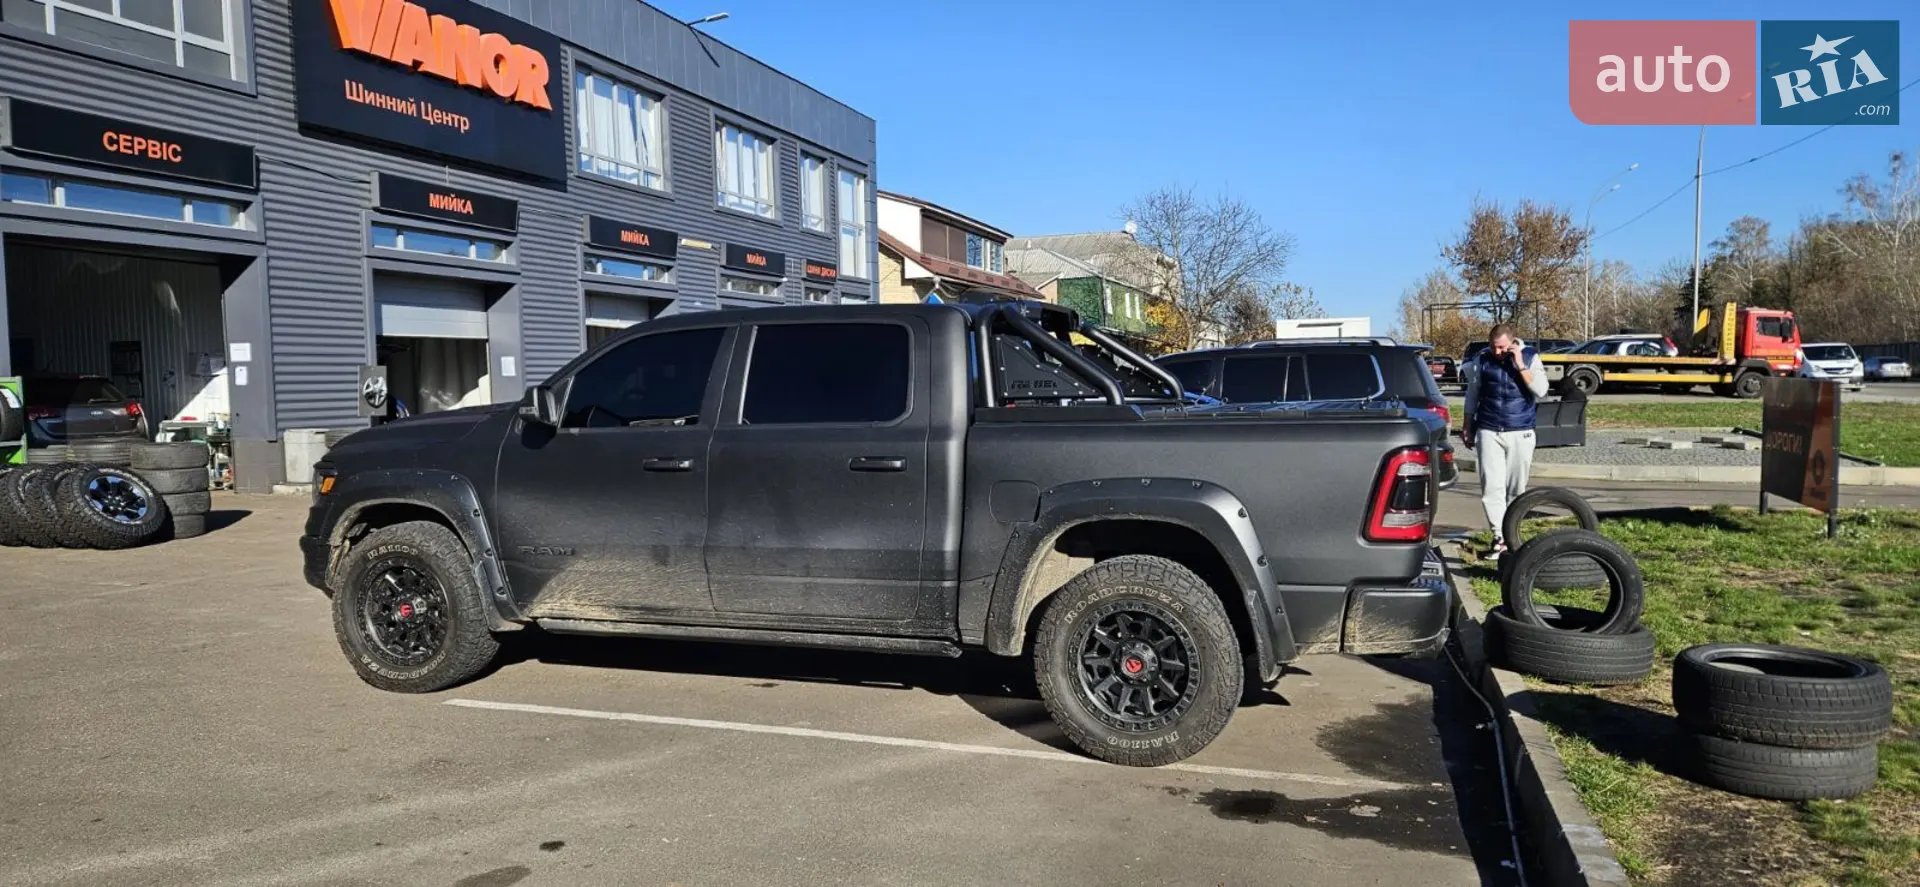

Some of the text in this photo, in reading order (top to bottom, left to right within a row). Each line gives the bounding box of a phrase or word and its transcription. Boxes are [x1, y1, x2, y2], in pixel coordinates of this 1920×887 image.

[329, 0, 553, 111] VIANOR
[344, 79, 470, 134] Шинний Центр
[102, 131, 182, 162] СЕРВІС
[429, 193, 474, 215] МИЙКА
[620, 230, 650, 246] МИЙКА
[518, 545, 576, 556] RAM
[1065, 584, 1186, 625] ROADCRUZA
